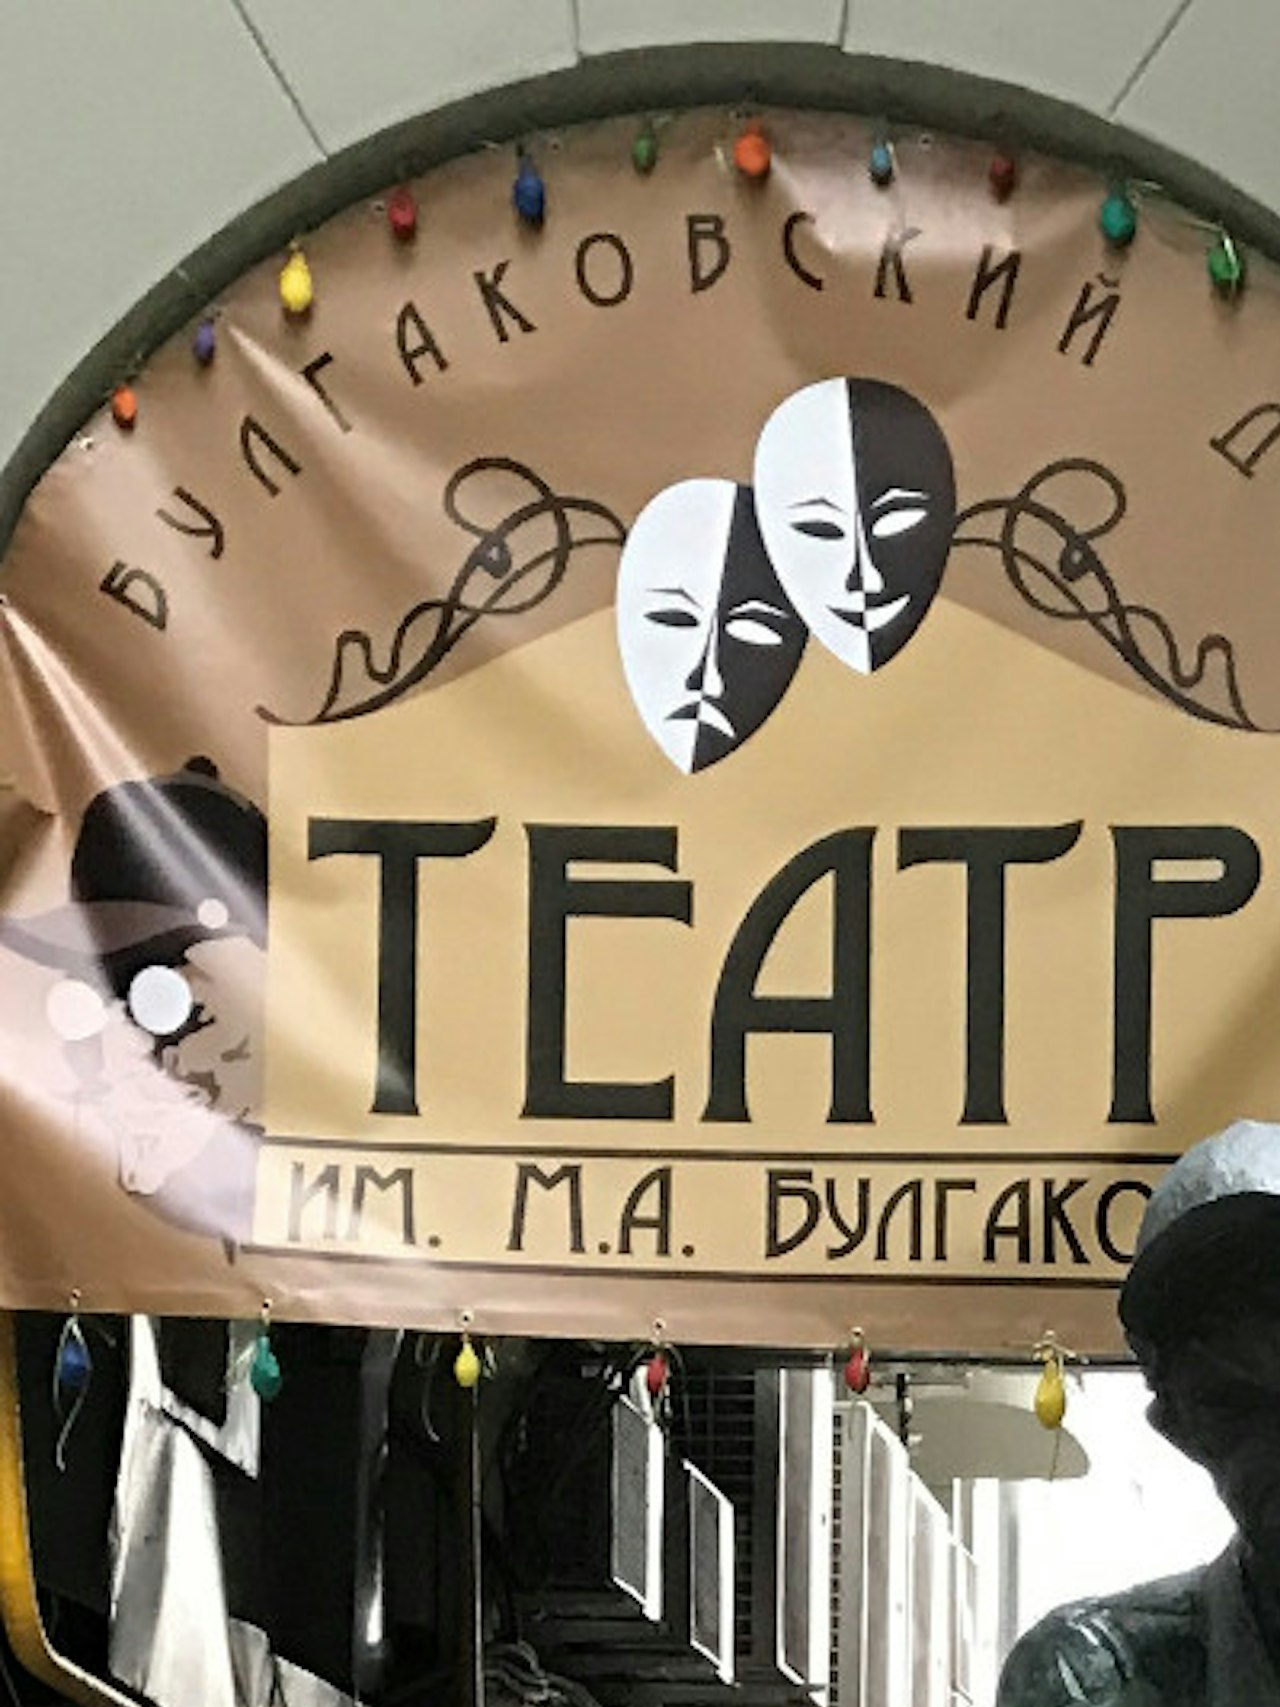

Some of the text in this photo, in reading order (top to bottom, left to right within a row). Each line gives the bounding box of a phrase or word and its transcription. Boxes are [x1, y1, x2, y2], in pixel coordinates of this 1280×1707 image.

[100, 210, 1123, 630] БУЛГАКОВСКИЙ
[306, 815, 1264, 1126] ТЕАТР
[288, 1159, 442, 1250] ИМ.
[505, 1162, 696, 1259] М.А.
